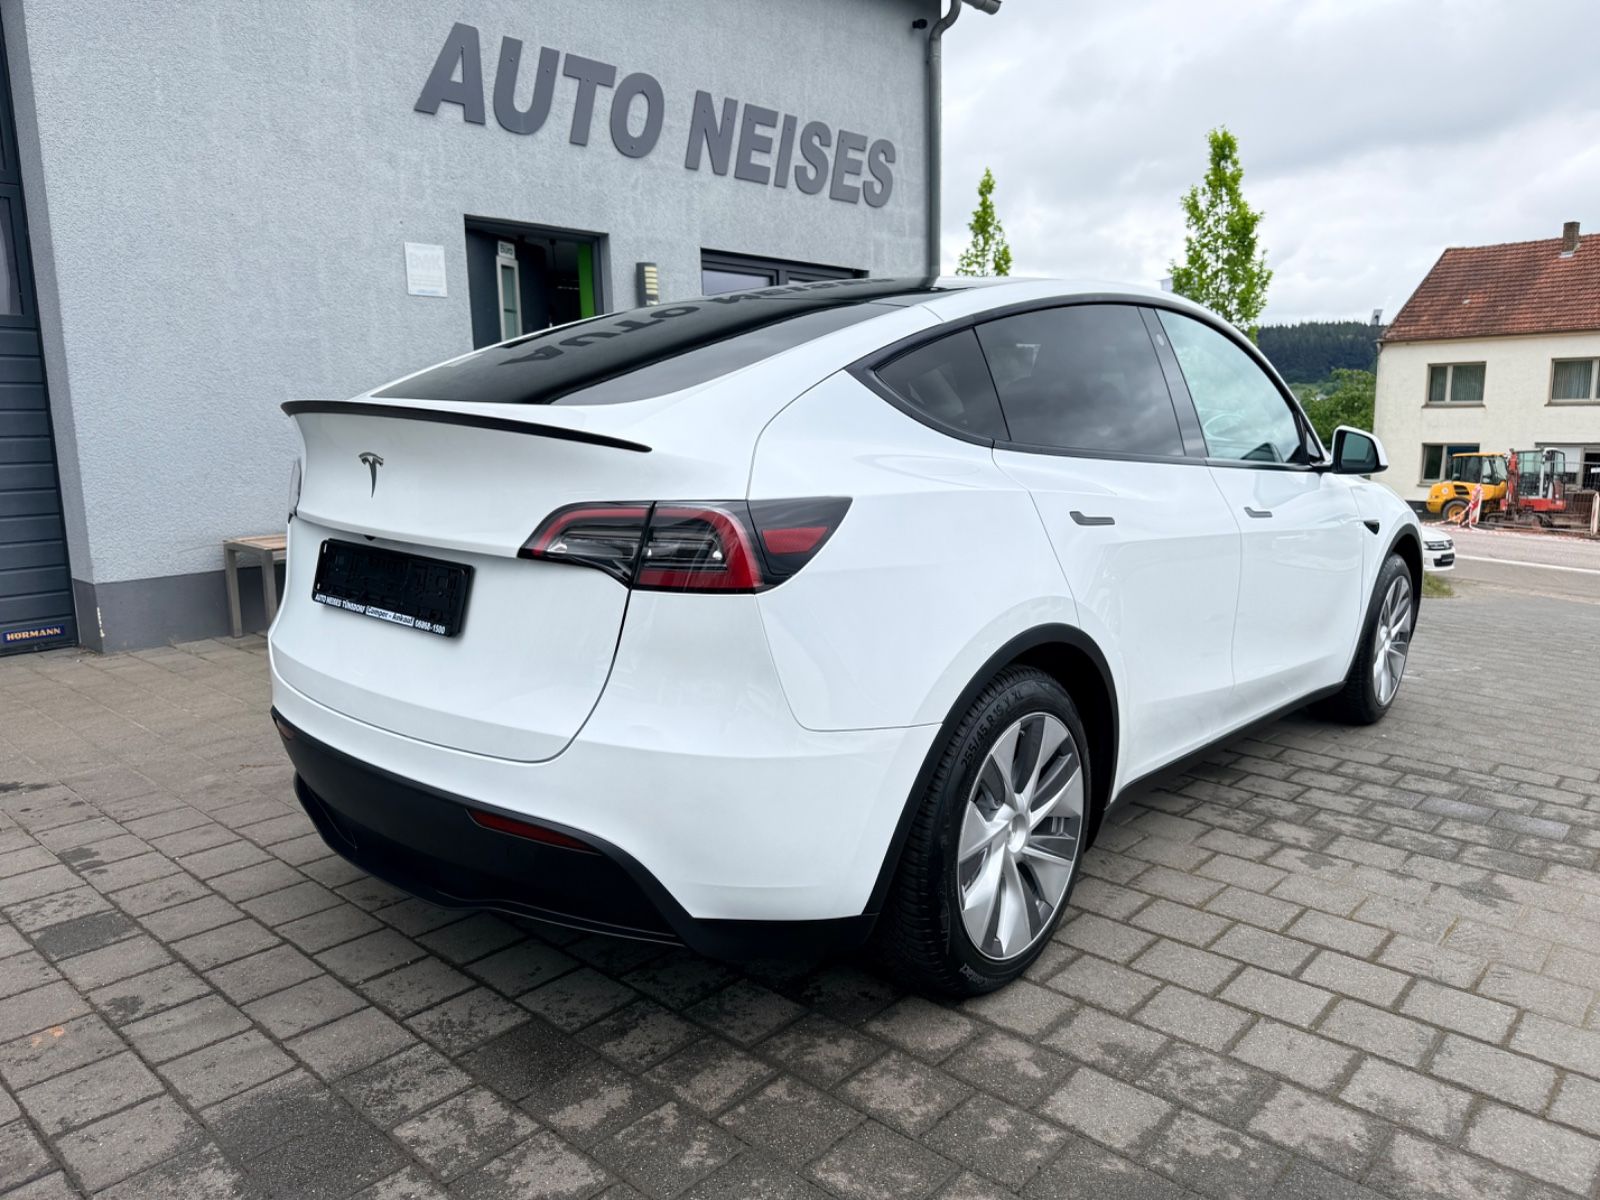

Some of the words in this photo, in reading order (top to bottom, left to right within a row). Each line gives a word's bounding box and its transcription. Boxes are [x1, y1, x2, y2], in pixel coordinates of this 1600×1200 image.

[414, 22, 665, 158] AUTO
[684, 89, 896, 208] NEISES
[367, 605, 388, 618] Camper
[960, 724, 988, 768] 255/45
